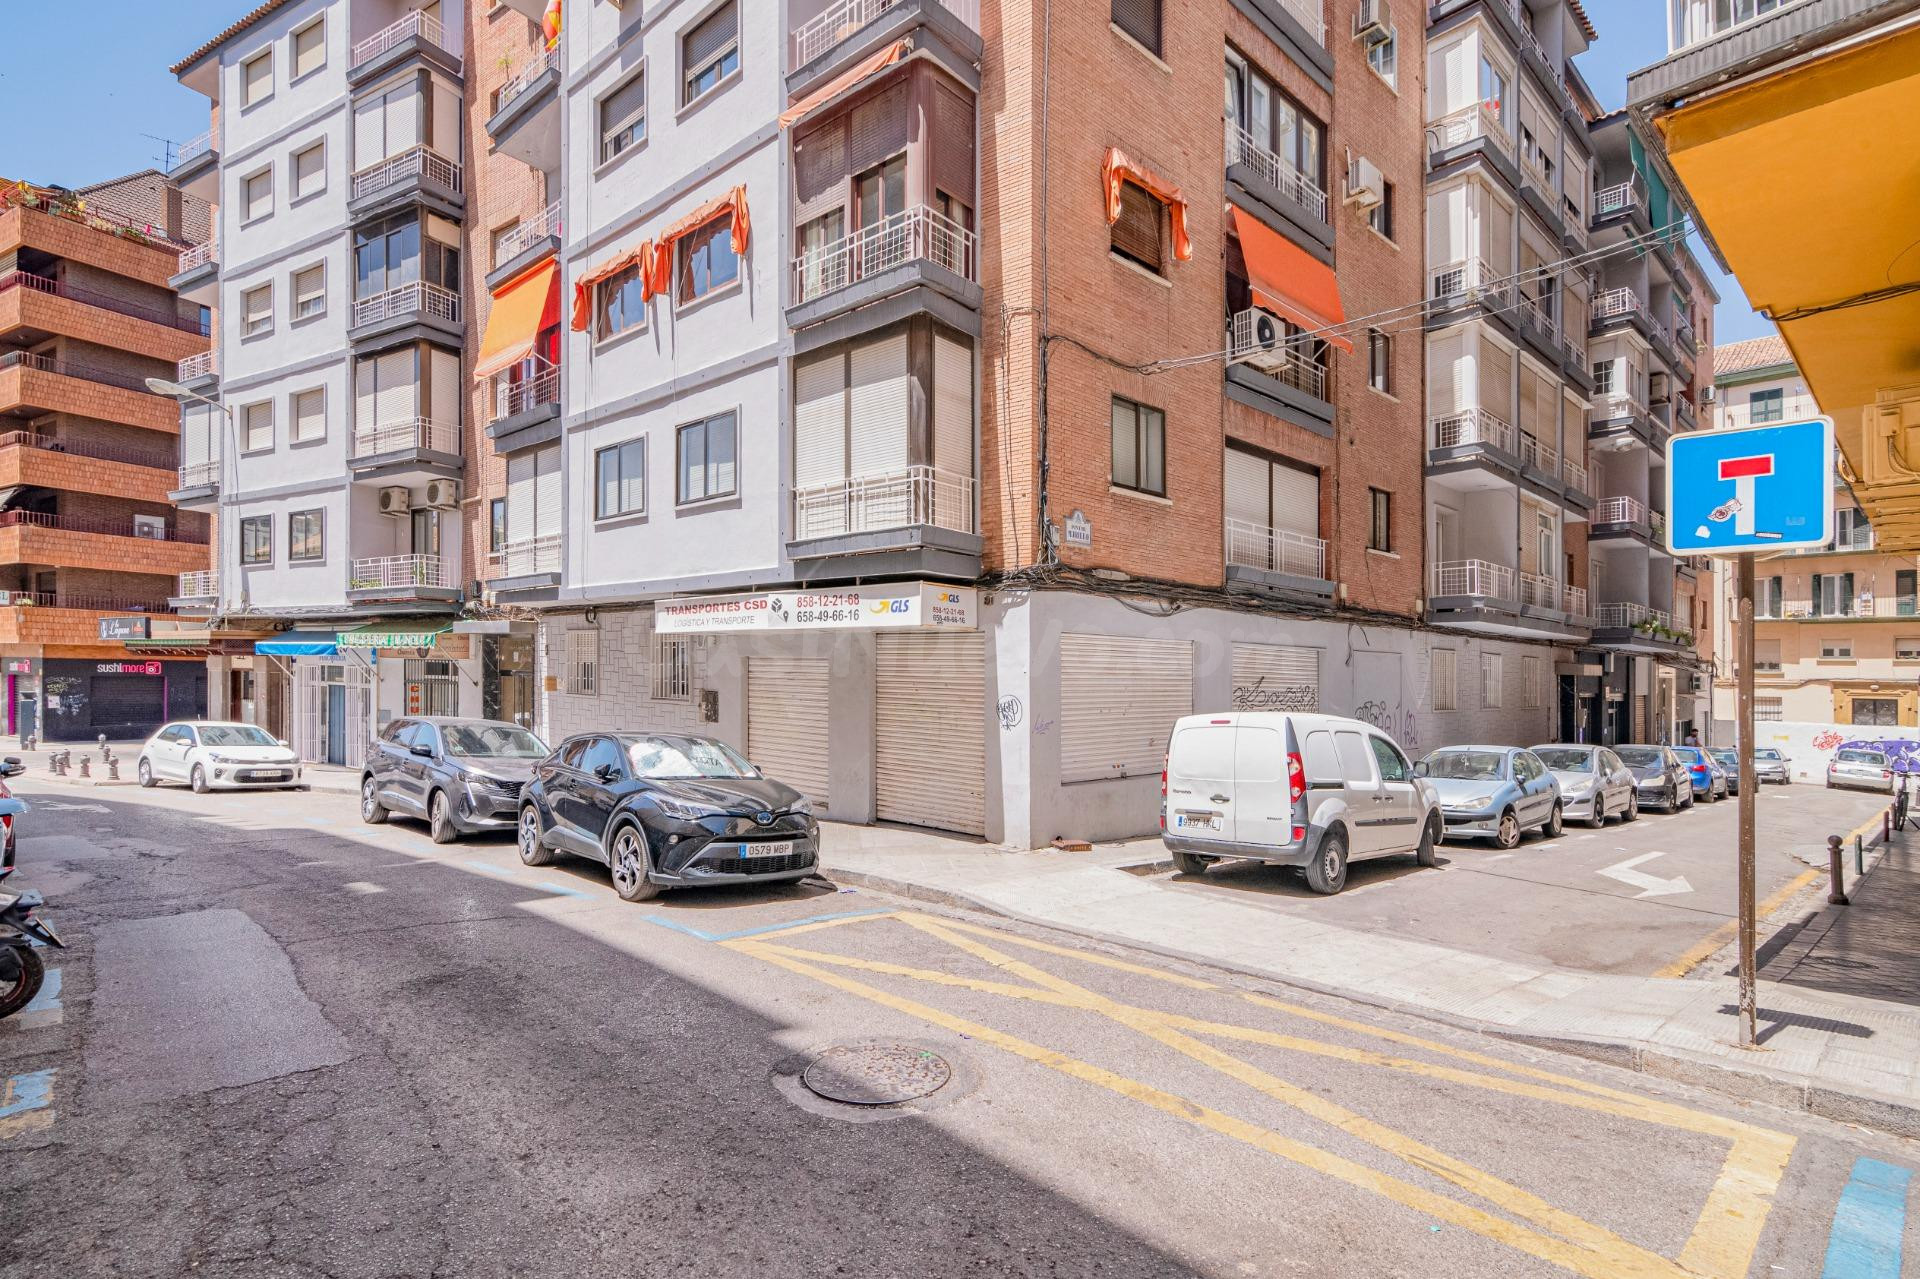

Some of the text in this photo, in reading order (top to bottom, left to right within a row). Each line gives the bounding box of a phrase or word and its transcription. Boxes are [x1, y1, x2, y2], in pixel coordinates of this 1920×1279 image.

[796, 593, 860, 608] 858-12-21-68
[948, 594, 960, 603] GLS
[664, 600, 768, 616] TRANSPORTES CSD
[890, 599, 910, 613] GLS
[711, 615, 756, 625] TRANSPORTE
[796, 609, 860, 623] 658-49-66-16
[97, 661, 145, 673] sushimore
[748, 844, 790, 856] 0579 MBP
